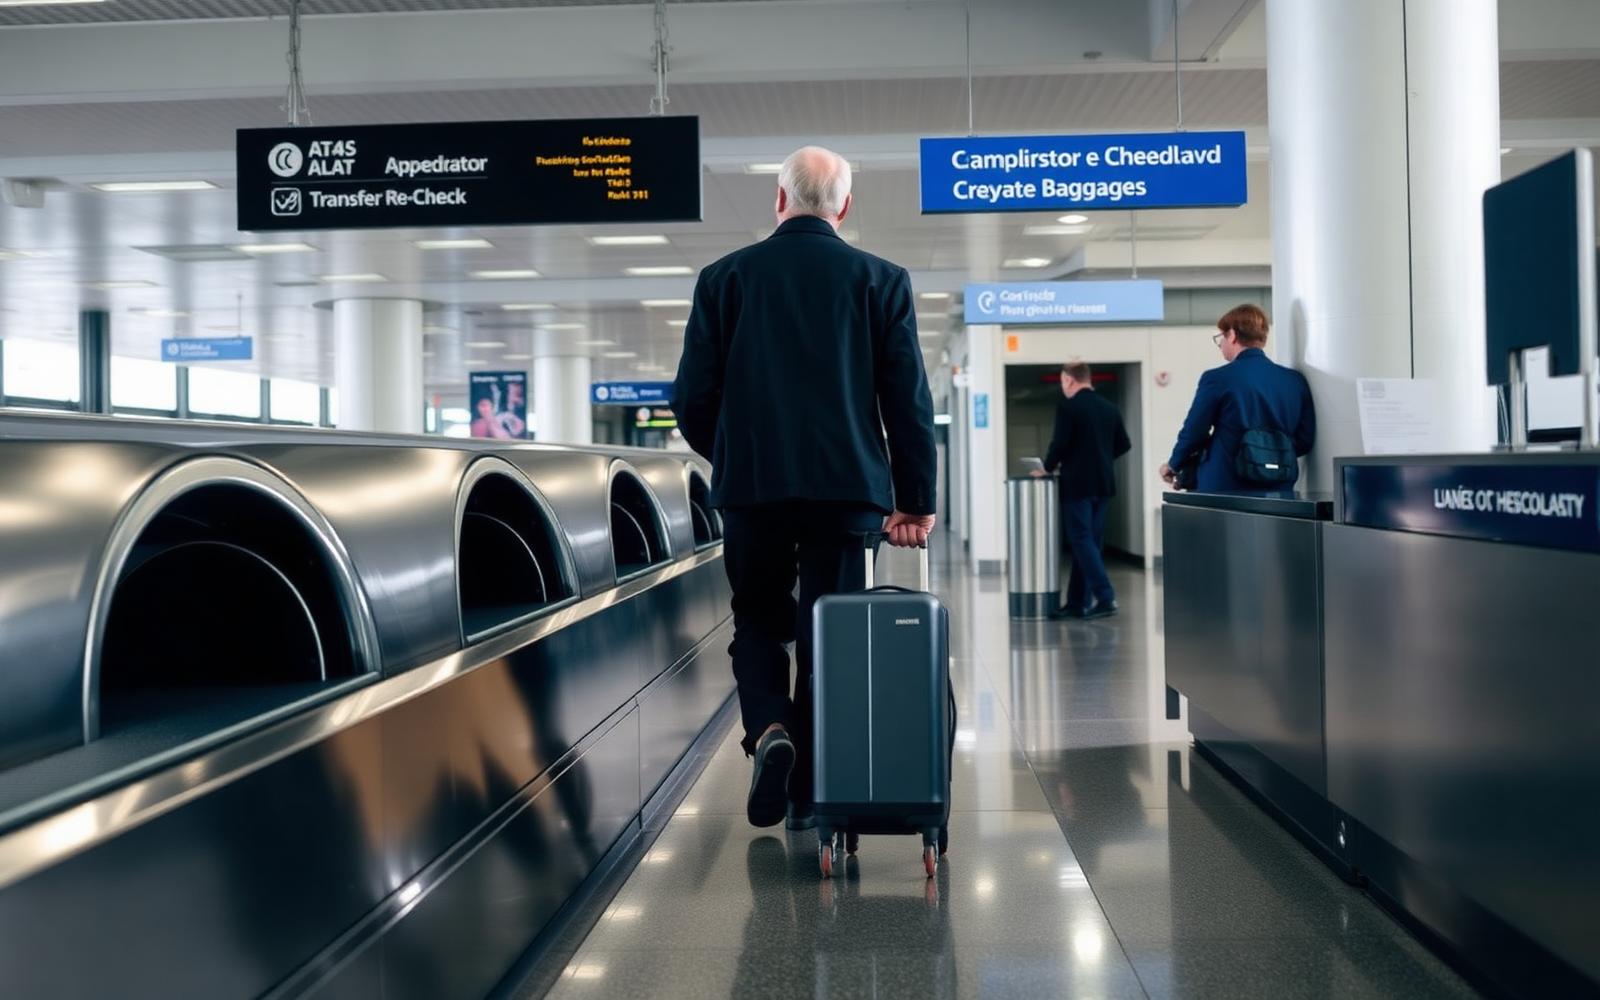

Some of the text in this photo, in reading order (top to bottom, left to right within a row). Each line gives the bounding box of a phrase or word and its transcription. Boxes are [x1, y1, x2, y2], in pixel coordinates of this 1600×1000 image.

[308, 159, 355, 175] ALAT
[1086, 152, 1099, 166] e
[310, 188, 466, 207] Transfer Re-Check
[953, 179, 1146, 202] Creyate Baggages
